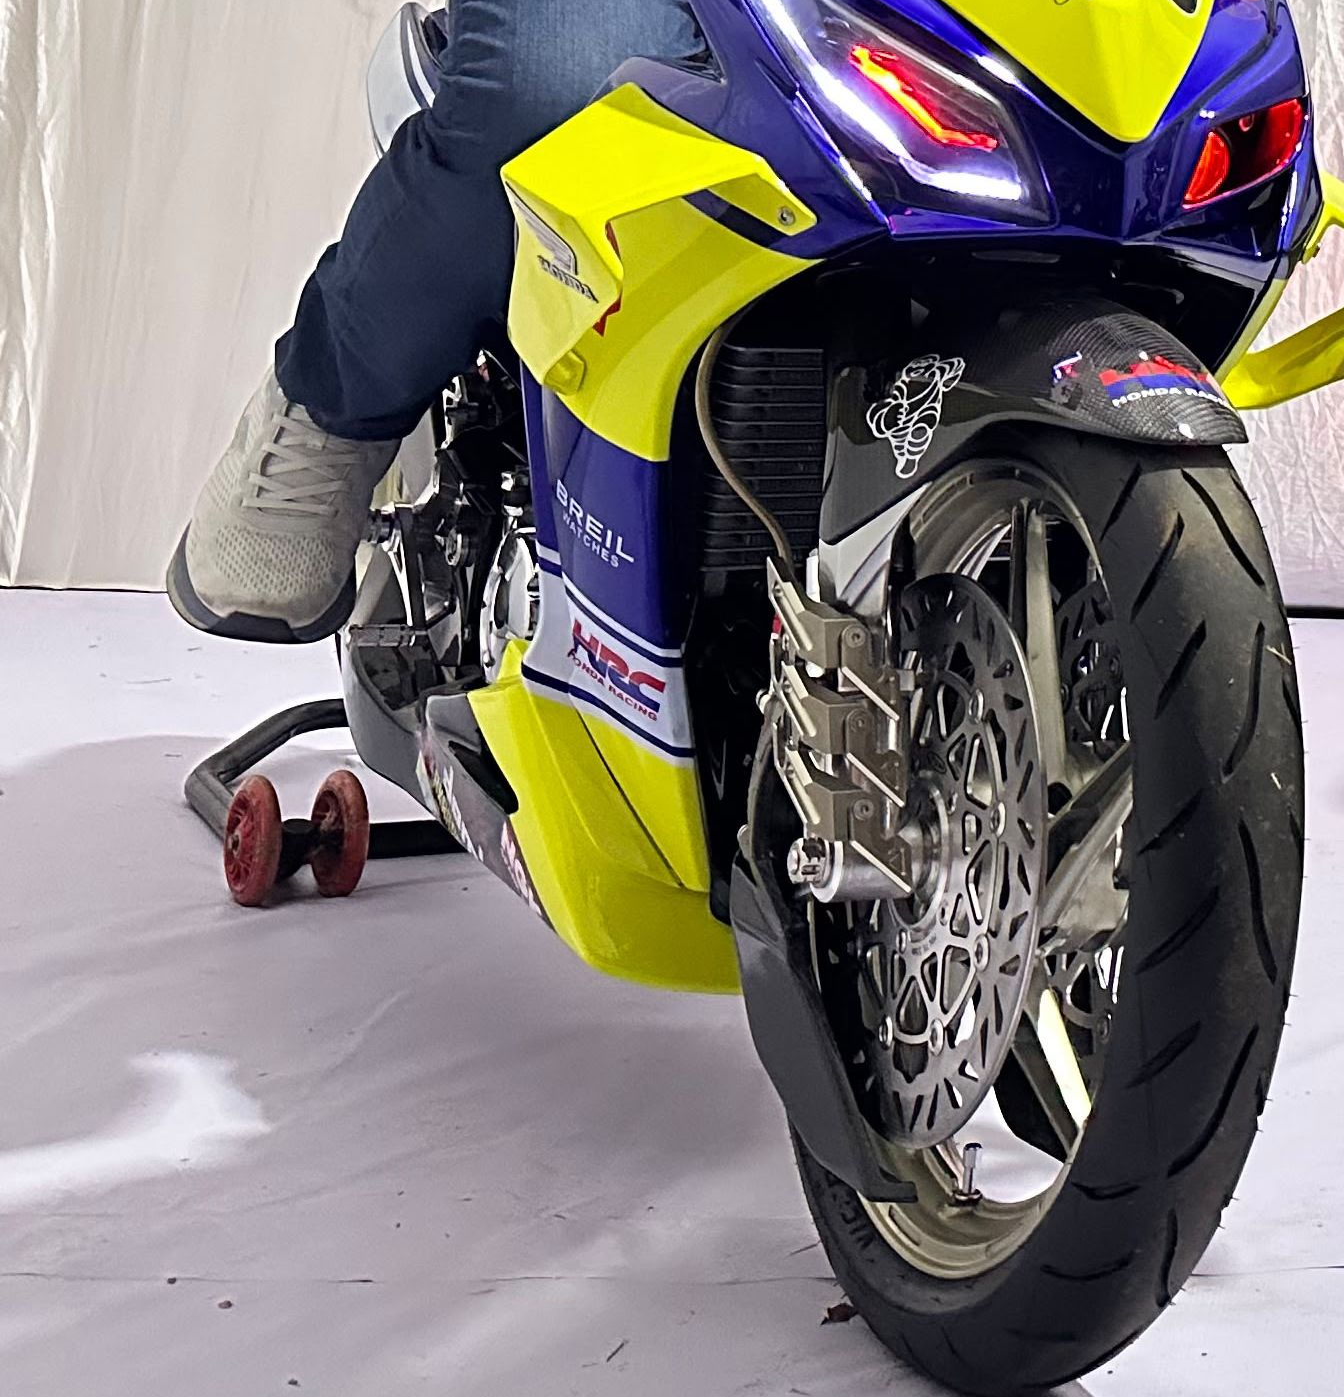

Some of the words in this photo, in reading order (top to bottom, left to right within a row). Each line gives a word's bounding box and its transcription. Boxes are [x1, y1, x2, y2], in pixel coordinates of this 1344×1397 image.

[1111, 386, 1183, 408] HONDA
[555, 478, 635, 564] BREIL
[562, 510, 620, 569] WATCHES
[571, 618, 667, 714] HRC
[608, 682, 659, 723] RACING
